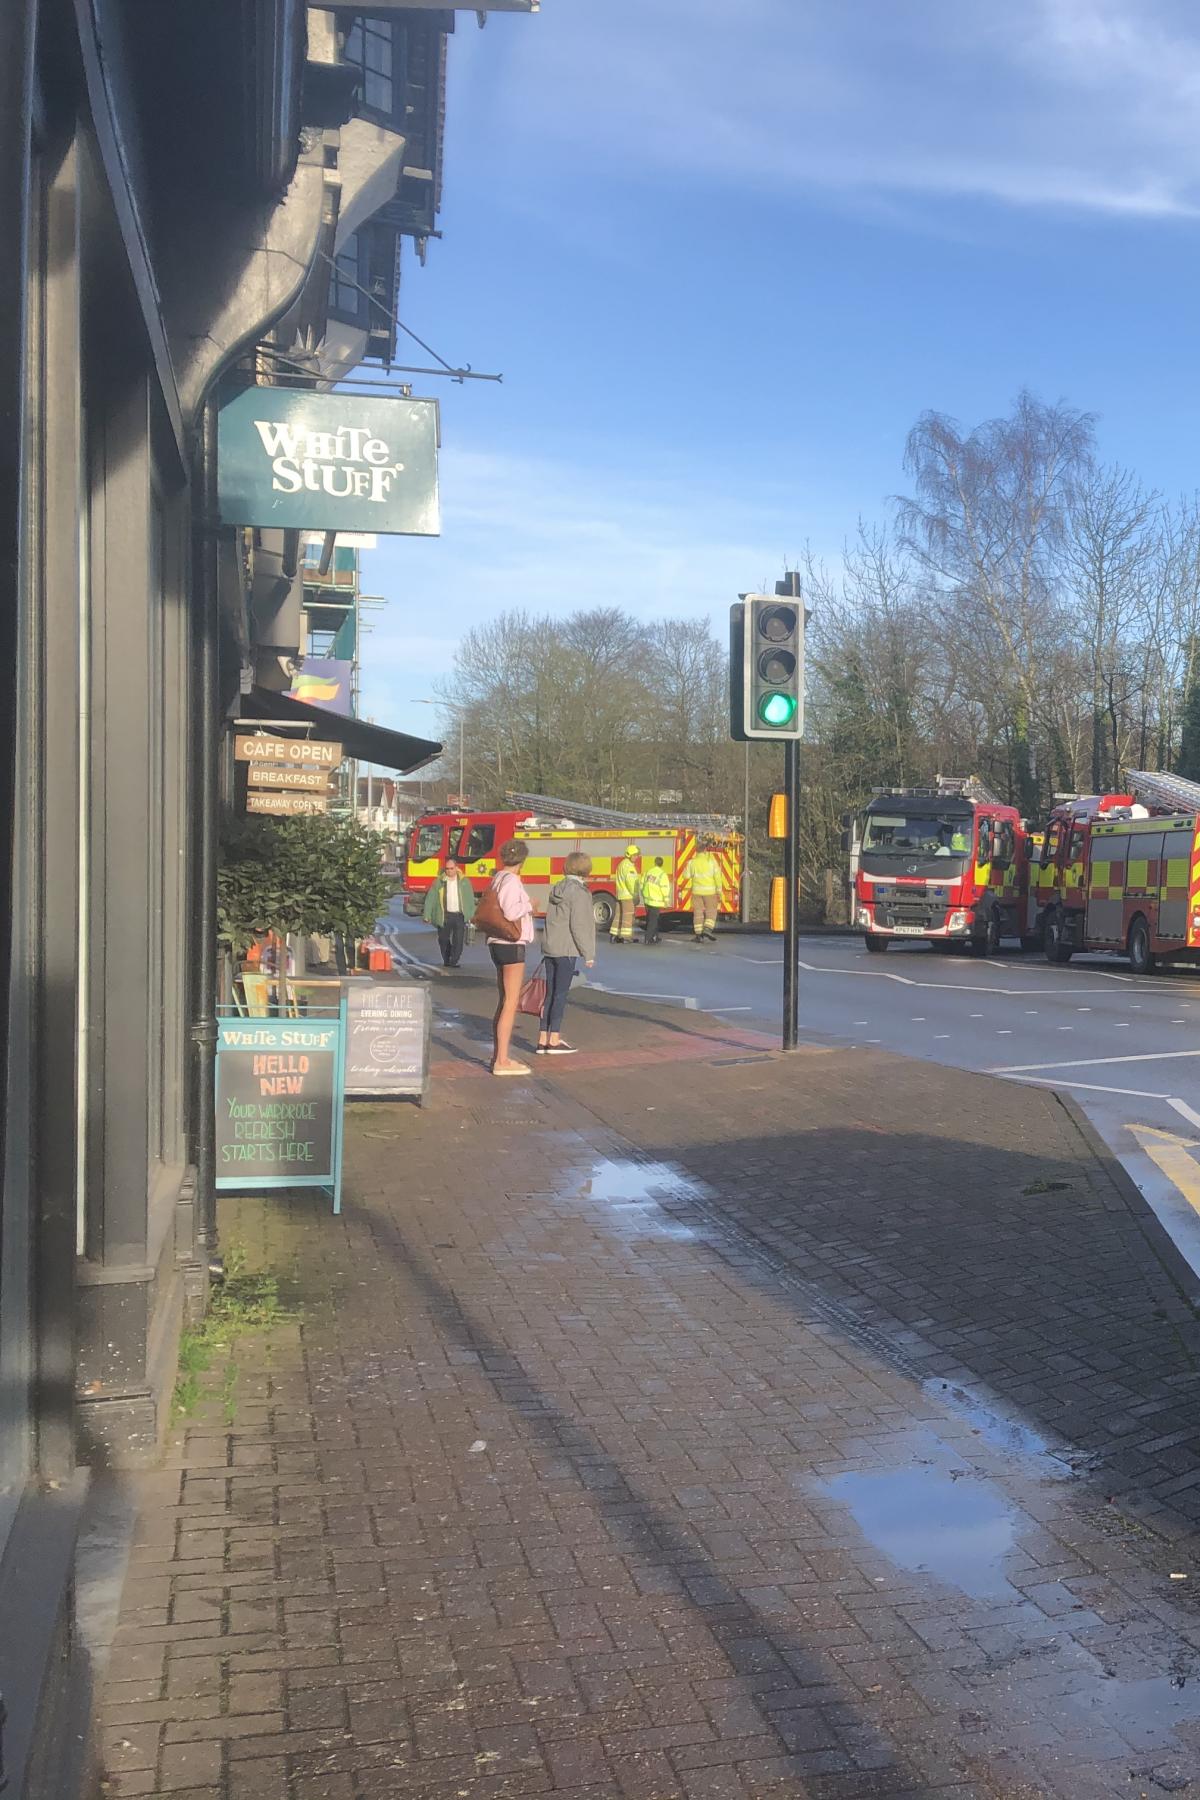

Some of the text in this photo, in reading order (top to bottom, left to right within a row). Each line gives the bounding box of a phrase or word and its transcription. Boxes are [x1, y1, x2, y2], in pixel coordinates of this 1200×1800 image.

[243, 741, 333, 762] CAFE OPEN
[252, 771, 323, 785] BREAKFAST
[250, 797, 291, 809] TAKEAWAY
[390, 1009, 413, 1018] DINING
[253, 1055, 310, 1076] HELLO
[260, 1076, 304, 1096] NEW
[234, 1120, 296, 1140] REFRESH
[221, 1141, 315, 1163] STARTS HERE
